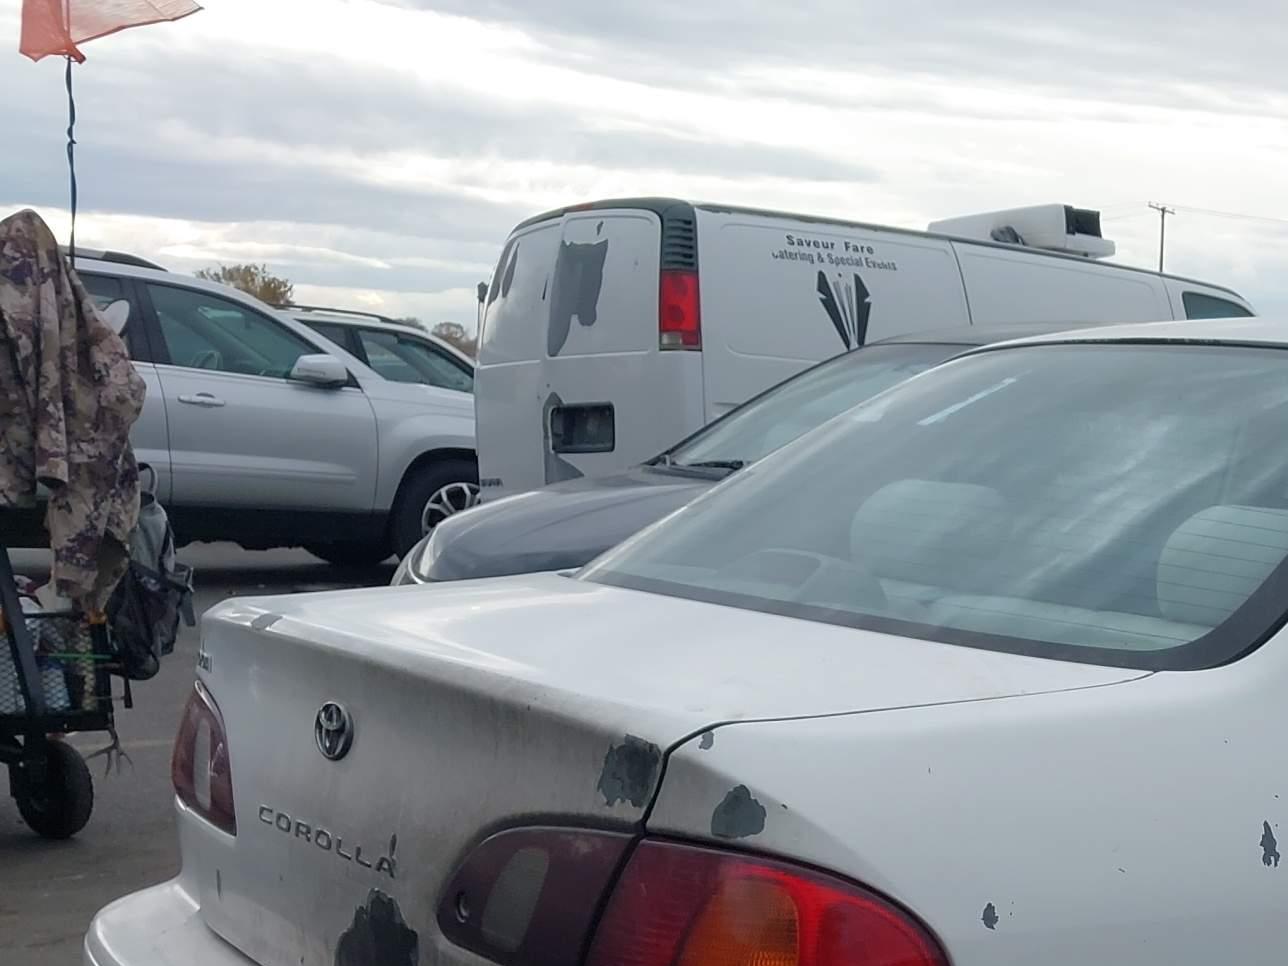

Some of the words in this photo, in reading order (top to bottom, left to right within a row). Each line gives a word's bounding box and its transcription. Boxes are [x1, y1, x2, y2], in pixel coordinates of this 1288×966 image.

[786, 234, 836, 250] Saveur
[844, 241, 875, 255] Fare
[817, 252, 825, 264] &
[826, 253, 863, 267] Special
[258, 805, 396, 878] COROLLA
